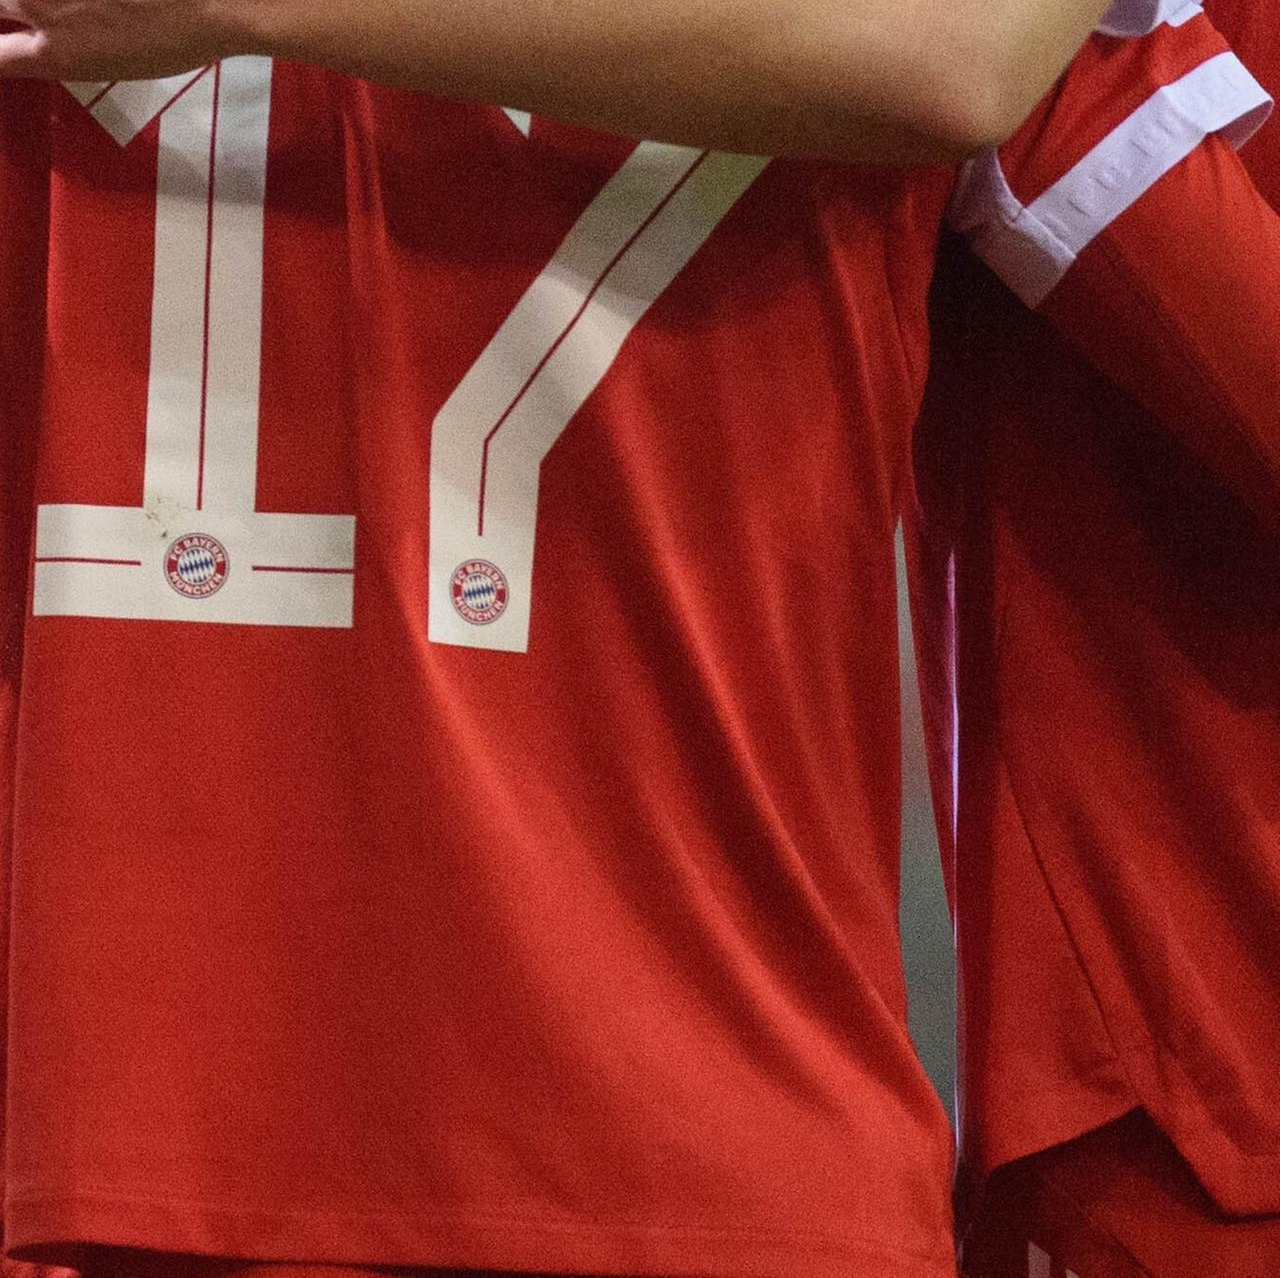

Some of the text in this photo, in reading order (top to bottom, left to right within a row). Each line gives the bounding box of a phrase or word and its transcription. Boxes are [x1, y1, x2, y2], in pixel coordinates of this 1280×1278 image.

[32, 53, 771, 653] 17
[170, 537, 225, 562] FC BAYERN
[465, 563, 505, 589] BAYERN
